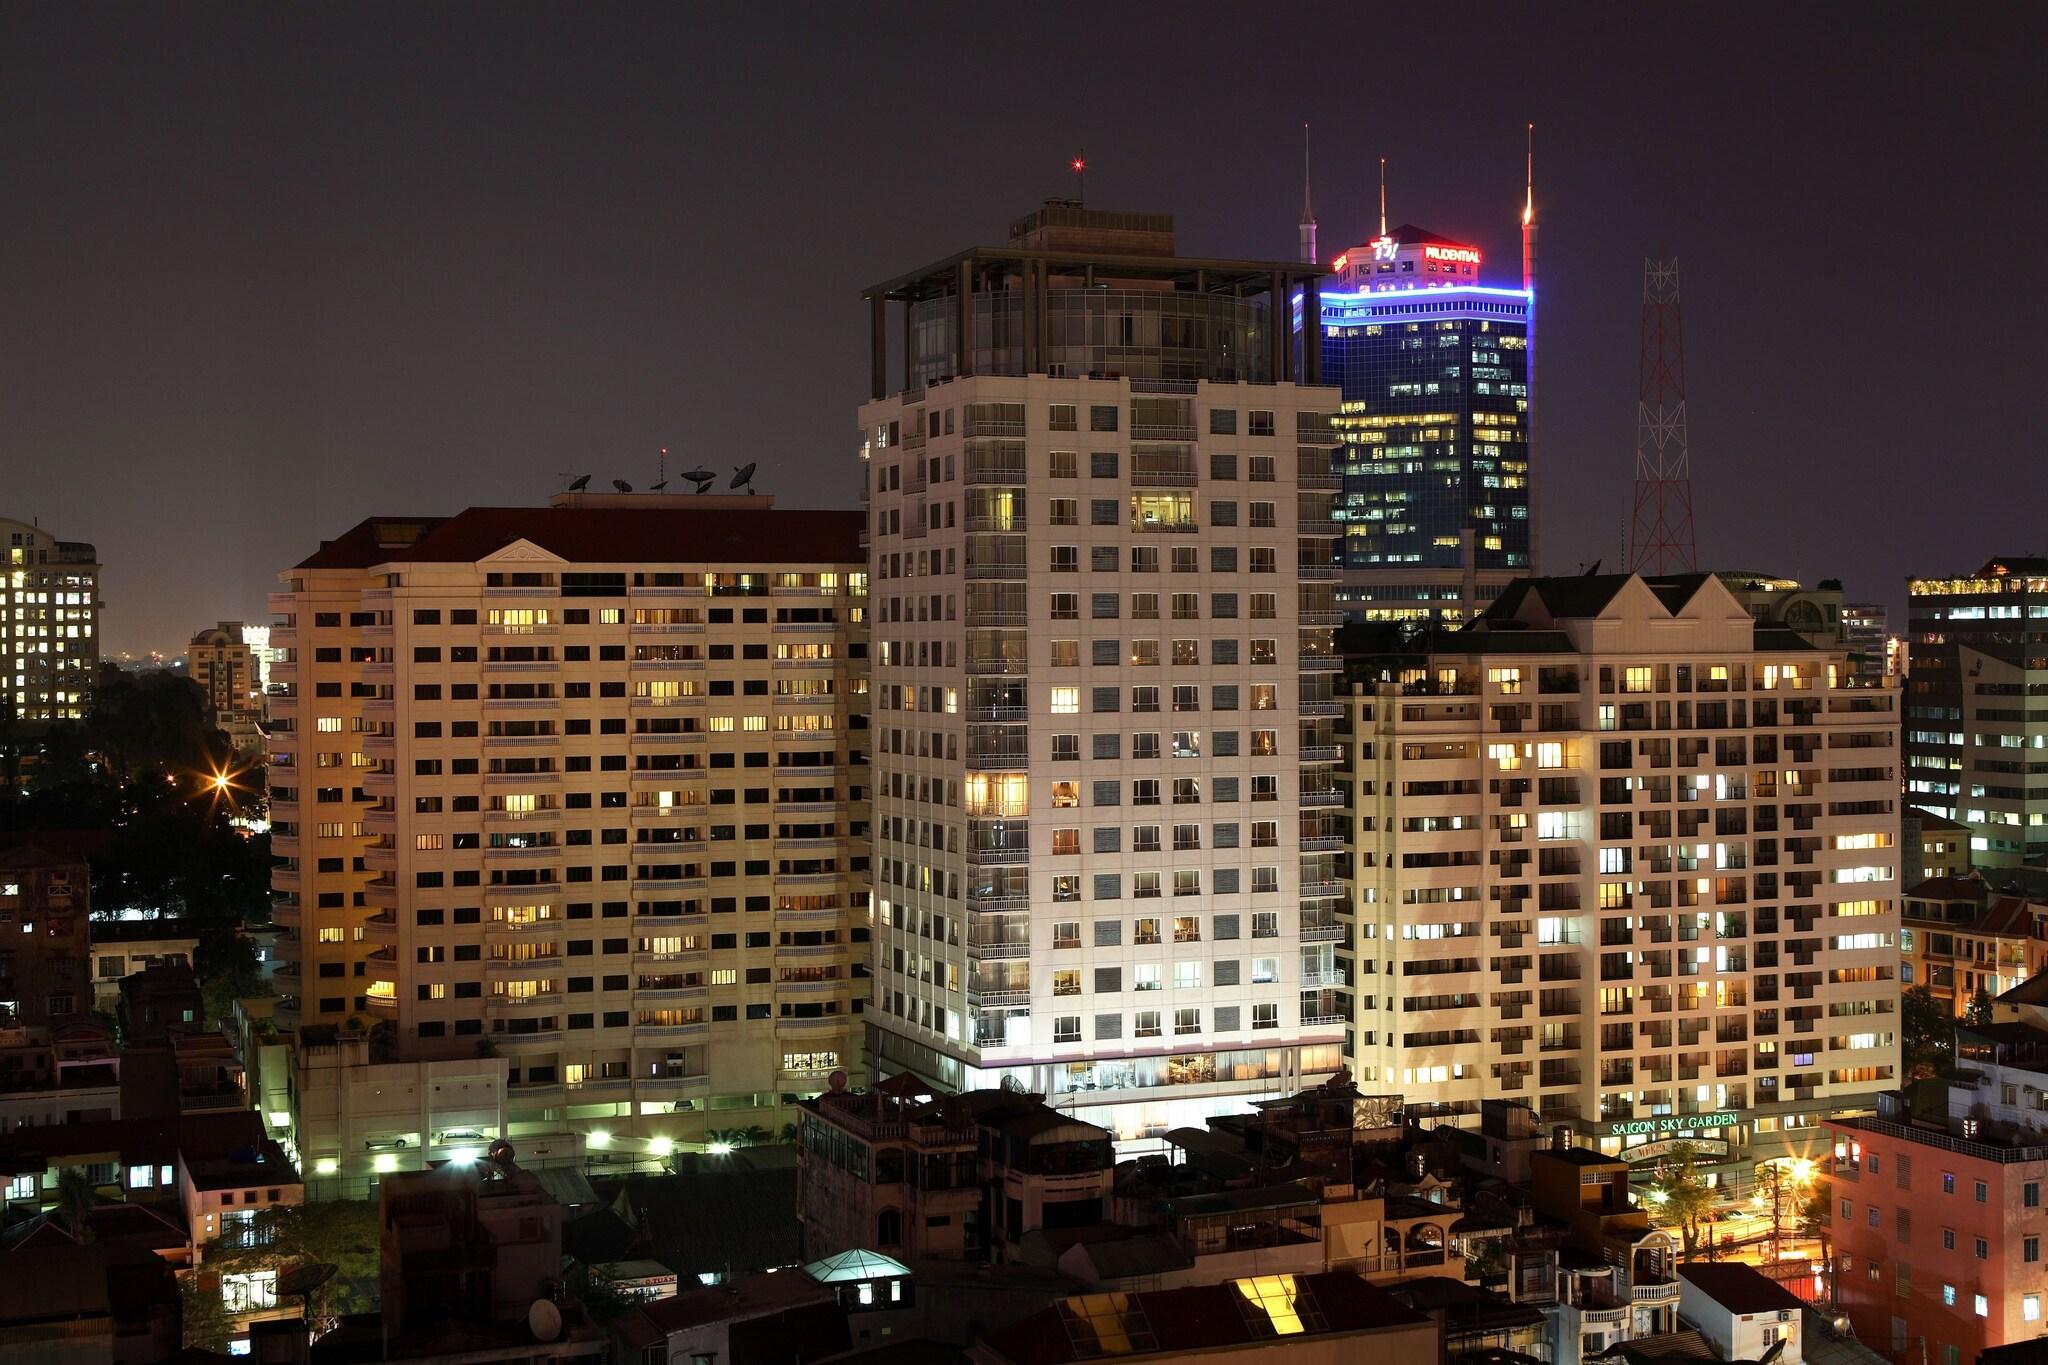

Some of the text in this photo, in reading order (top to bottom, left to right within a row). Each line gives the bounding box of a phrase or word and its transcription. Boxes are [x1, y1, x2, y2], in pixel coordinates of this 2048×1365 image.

[1425, 247, 1480, 263] PRUDENTIAL
[1612, 1114, 1737, 1135] SAIGON SKY GARDEN
